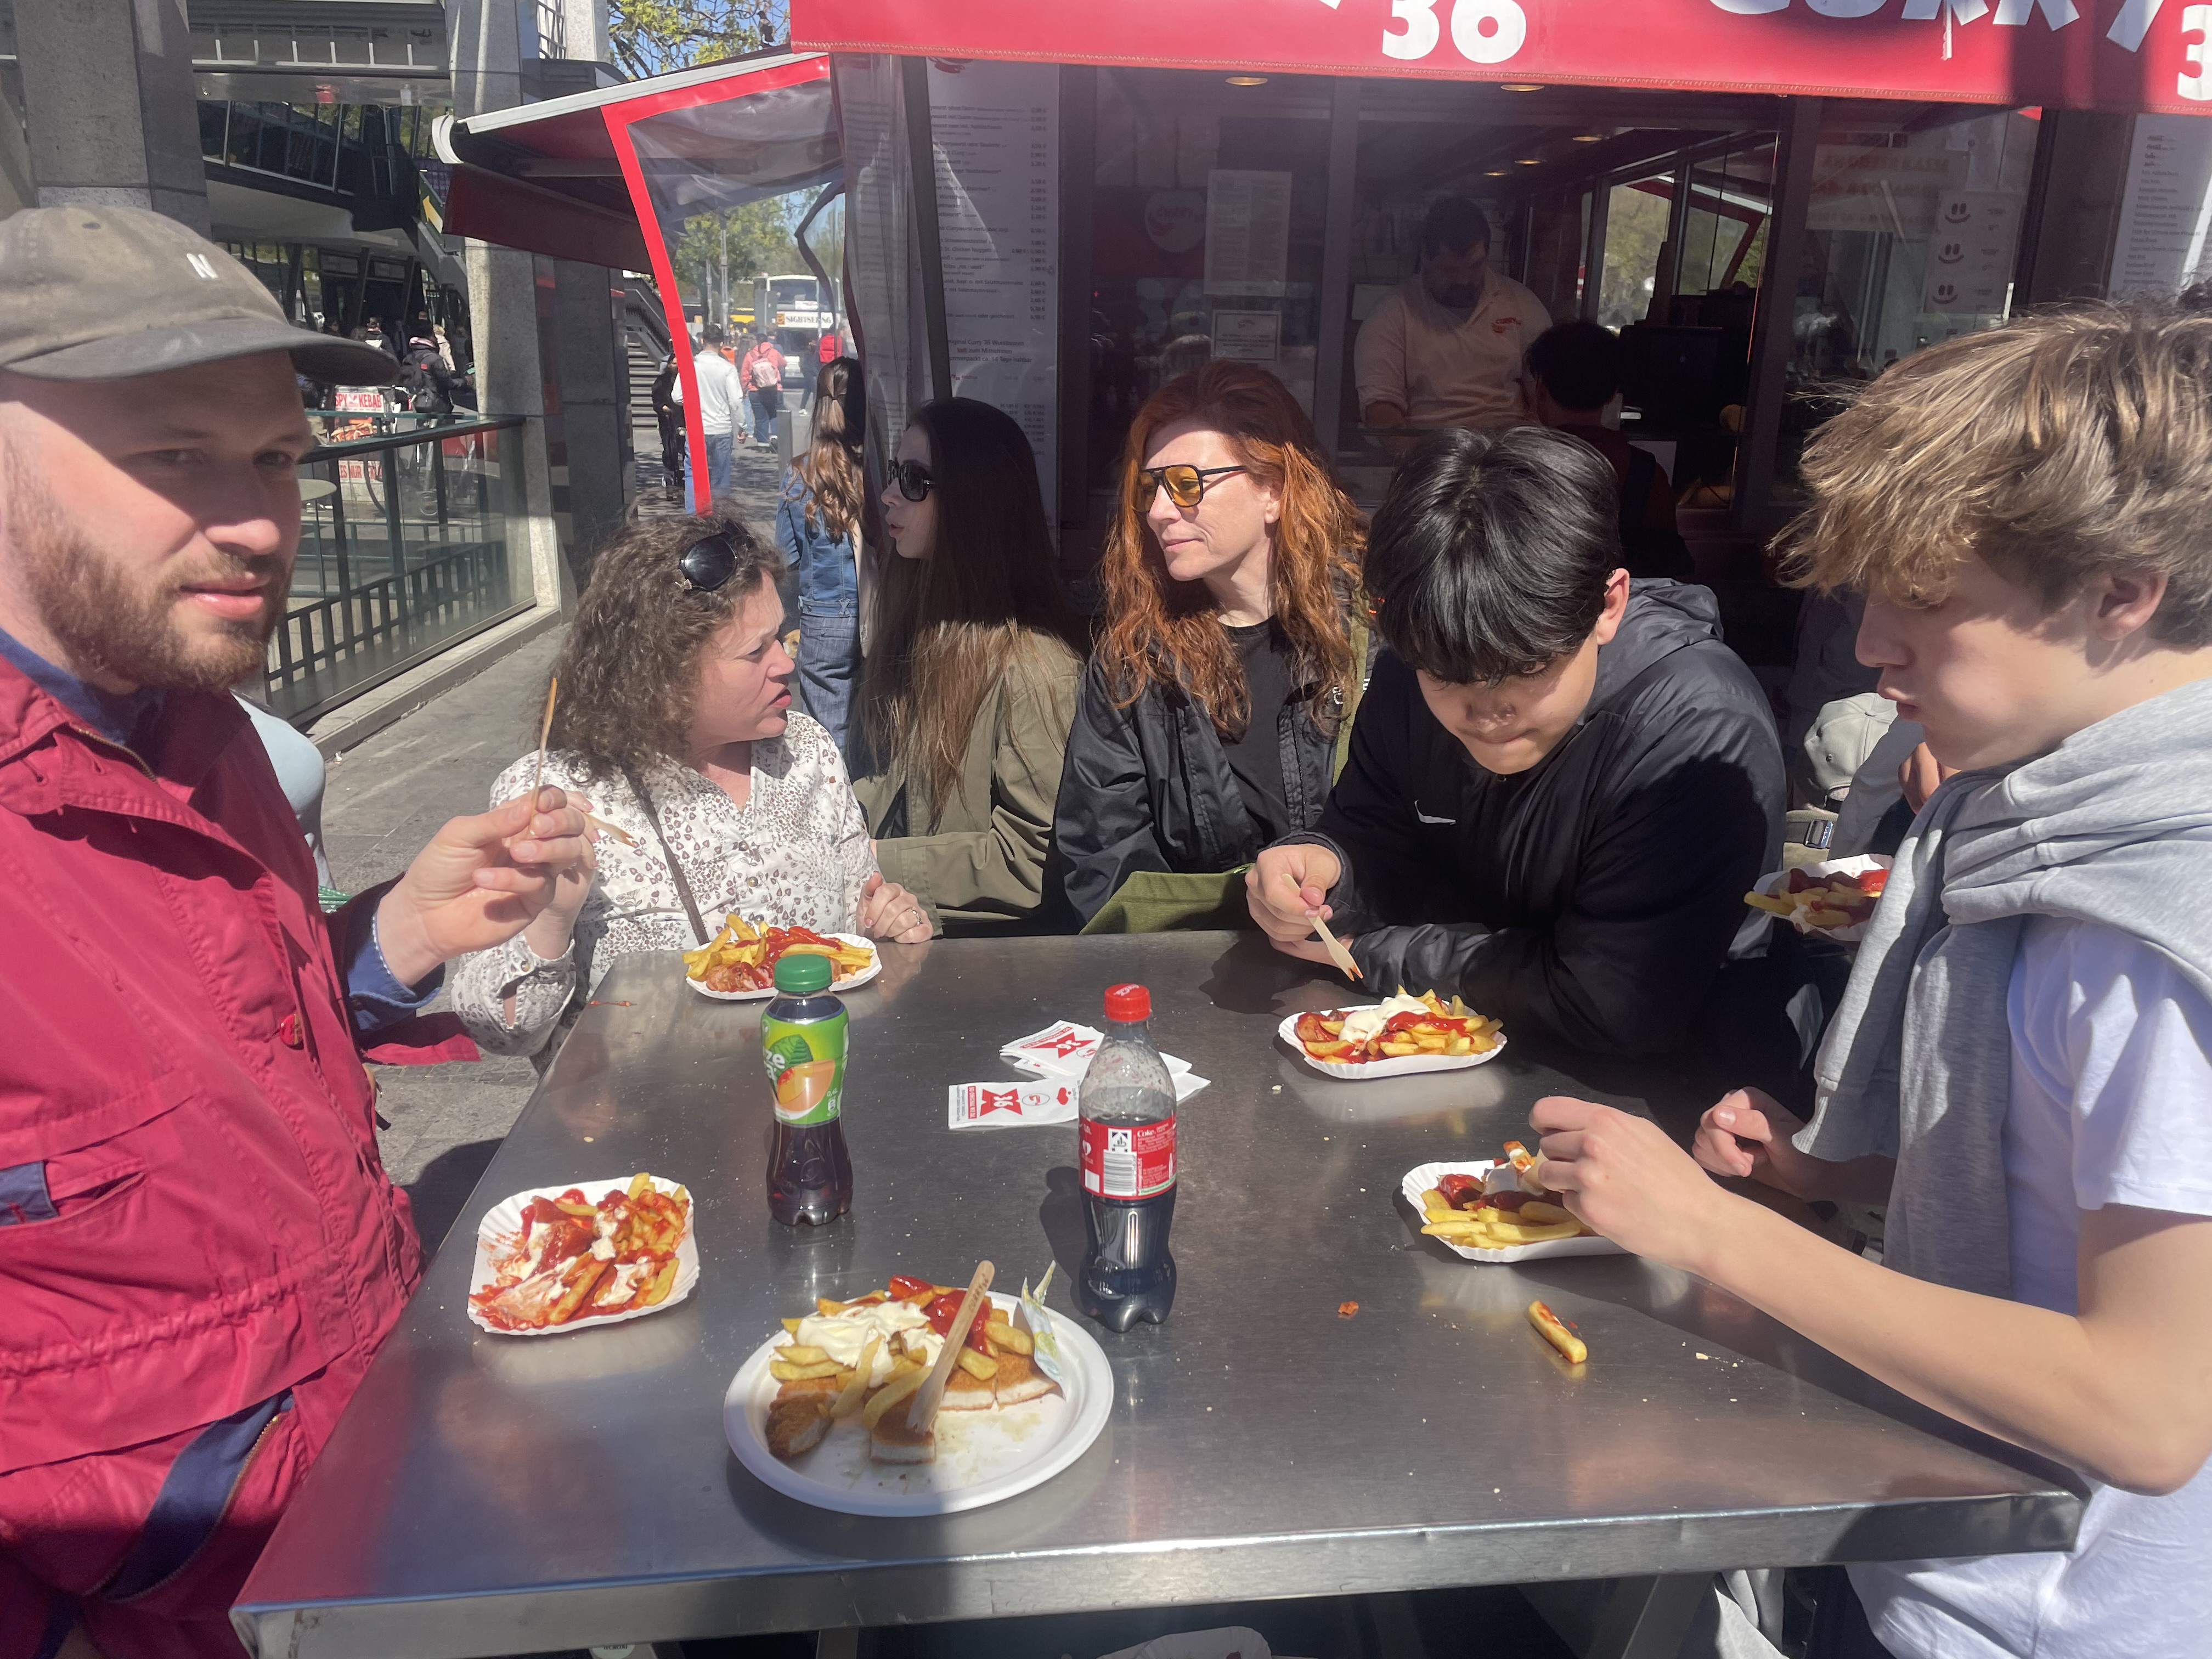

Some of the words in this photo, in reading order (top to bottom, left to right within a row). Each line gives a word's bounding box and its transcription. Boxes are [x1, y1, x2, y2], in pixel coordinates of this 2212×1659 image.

[1382, 0, 1527, 64] 36
[358, 394, 382, 408] KEBAB
[1056, 1040, 1082, 1050] 36
[994, 1096, 1013, 1107] 36
[1137, 1129, 1155, 1138] Coke
